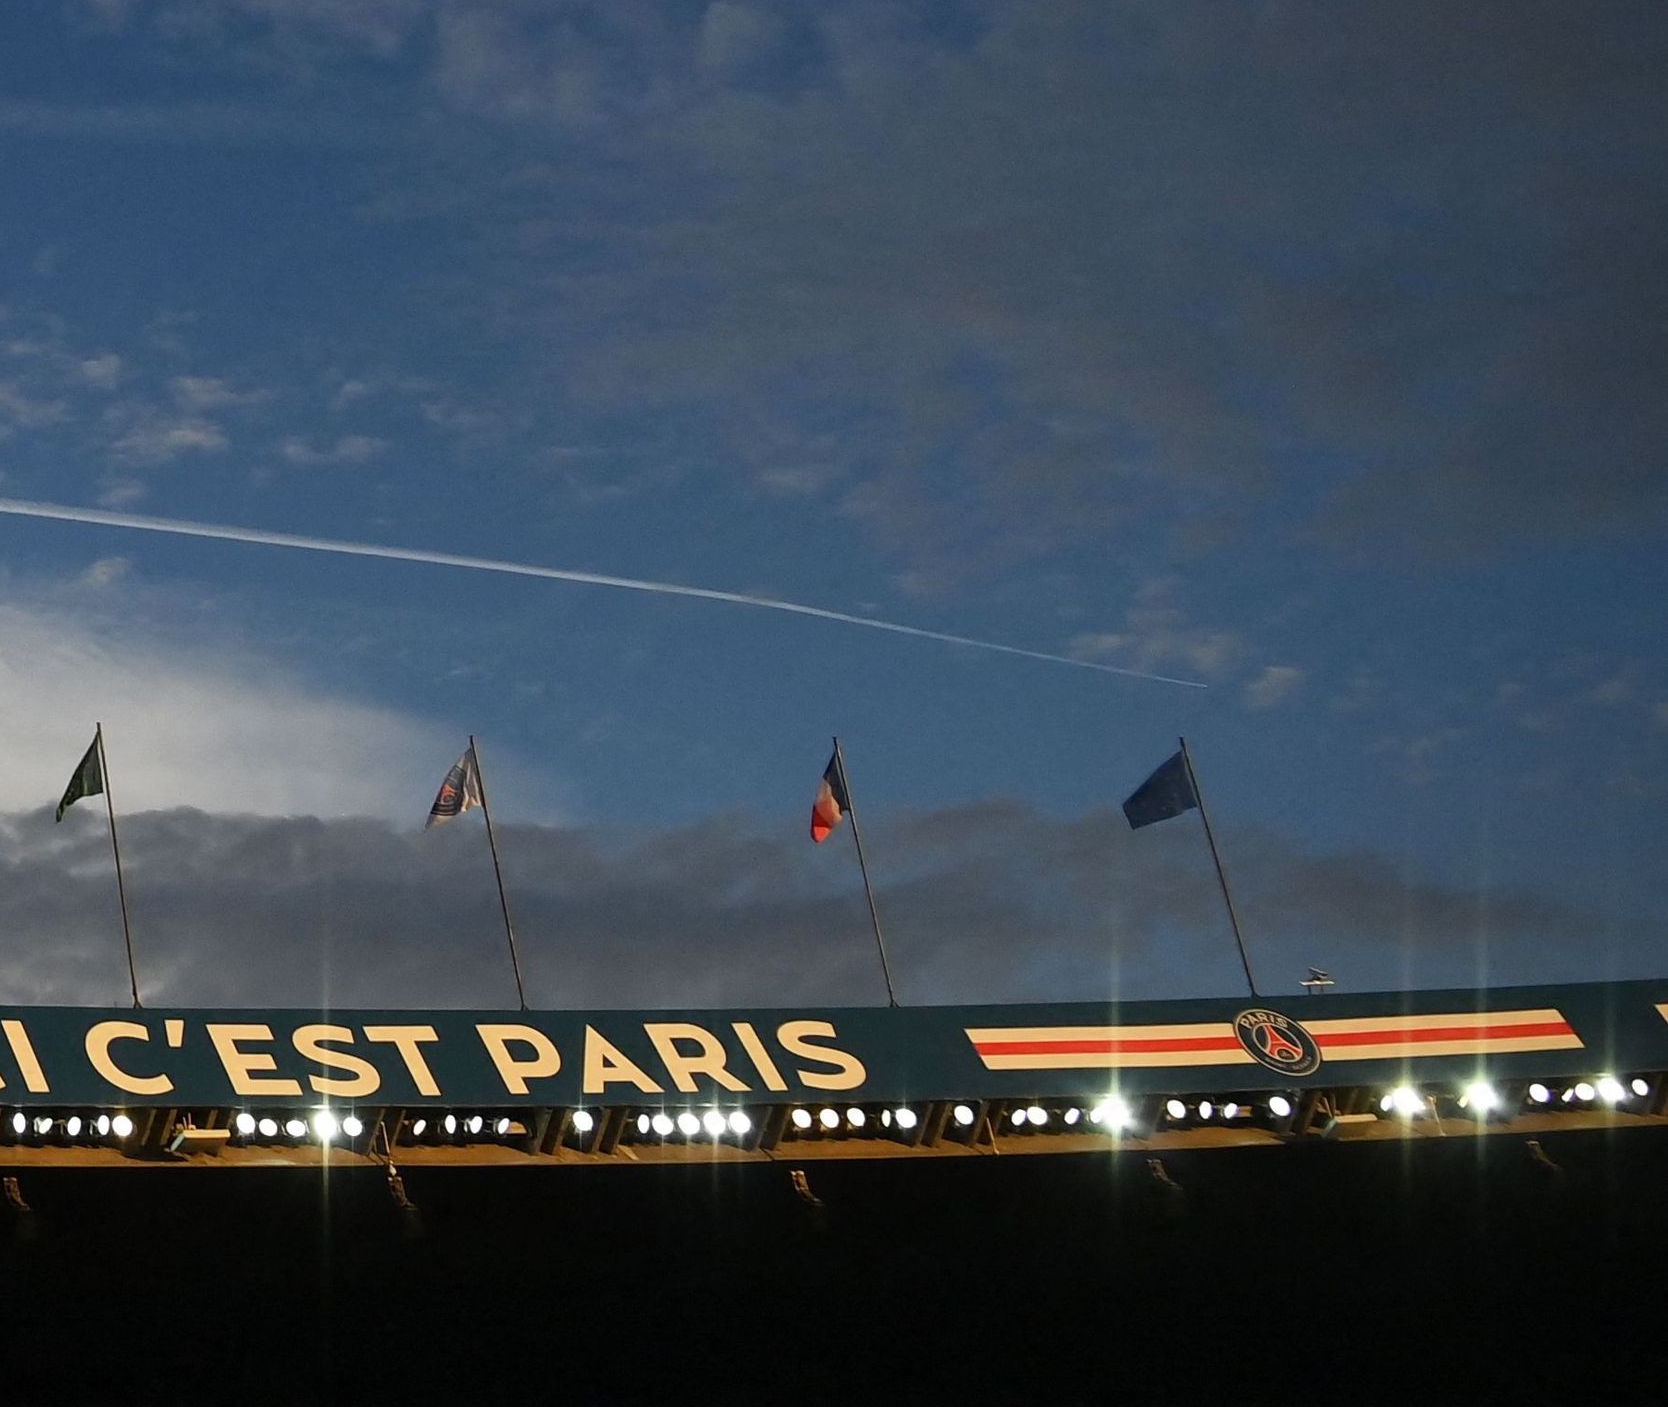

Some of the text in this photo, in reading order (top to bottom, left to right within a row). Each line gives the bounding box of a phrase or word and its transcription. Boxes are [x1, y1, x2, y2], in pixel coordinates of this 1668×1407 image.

[1240, 1012, 1288, 1029] PARIS
[84, 1019, 441, 1098] C'EST
[475, 1020, 867, 1095] PARIS
